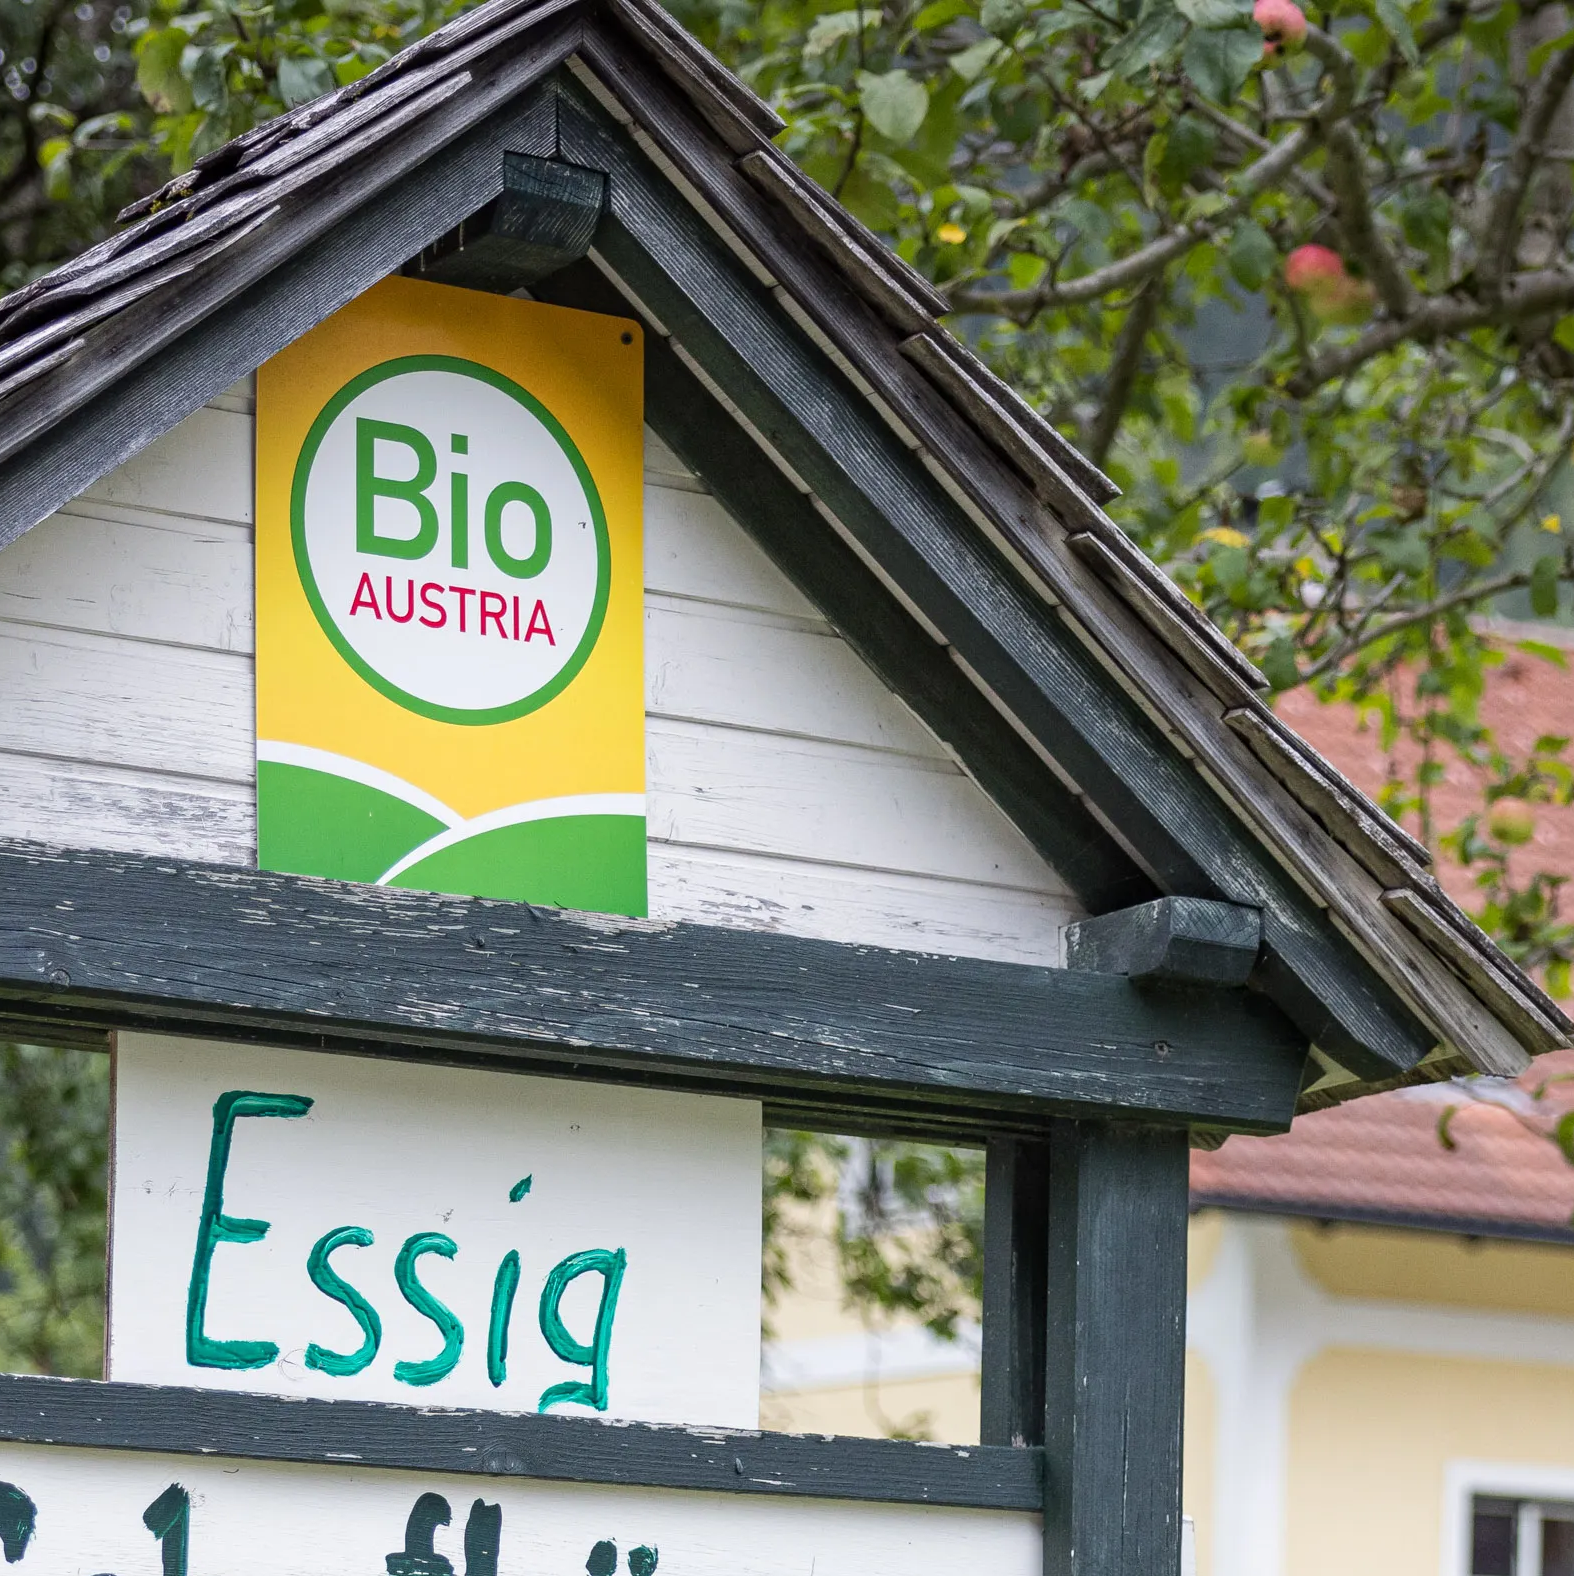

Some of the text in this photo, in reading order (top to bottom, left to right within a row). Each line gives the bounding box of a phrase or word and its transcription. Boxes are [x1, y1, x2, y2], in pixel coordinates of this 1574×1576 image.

[355, 416, 553, 580] Bio
[349, 572, 556, 647] AUSTRIA
[186, 1090, 627, 1412] Essig
